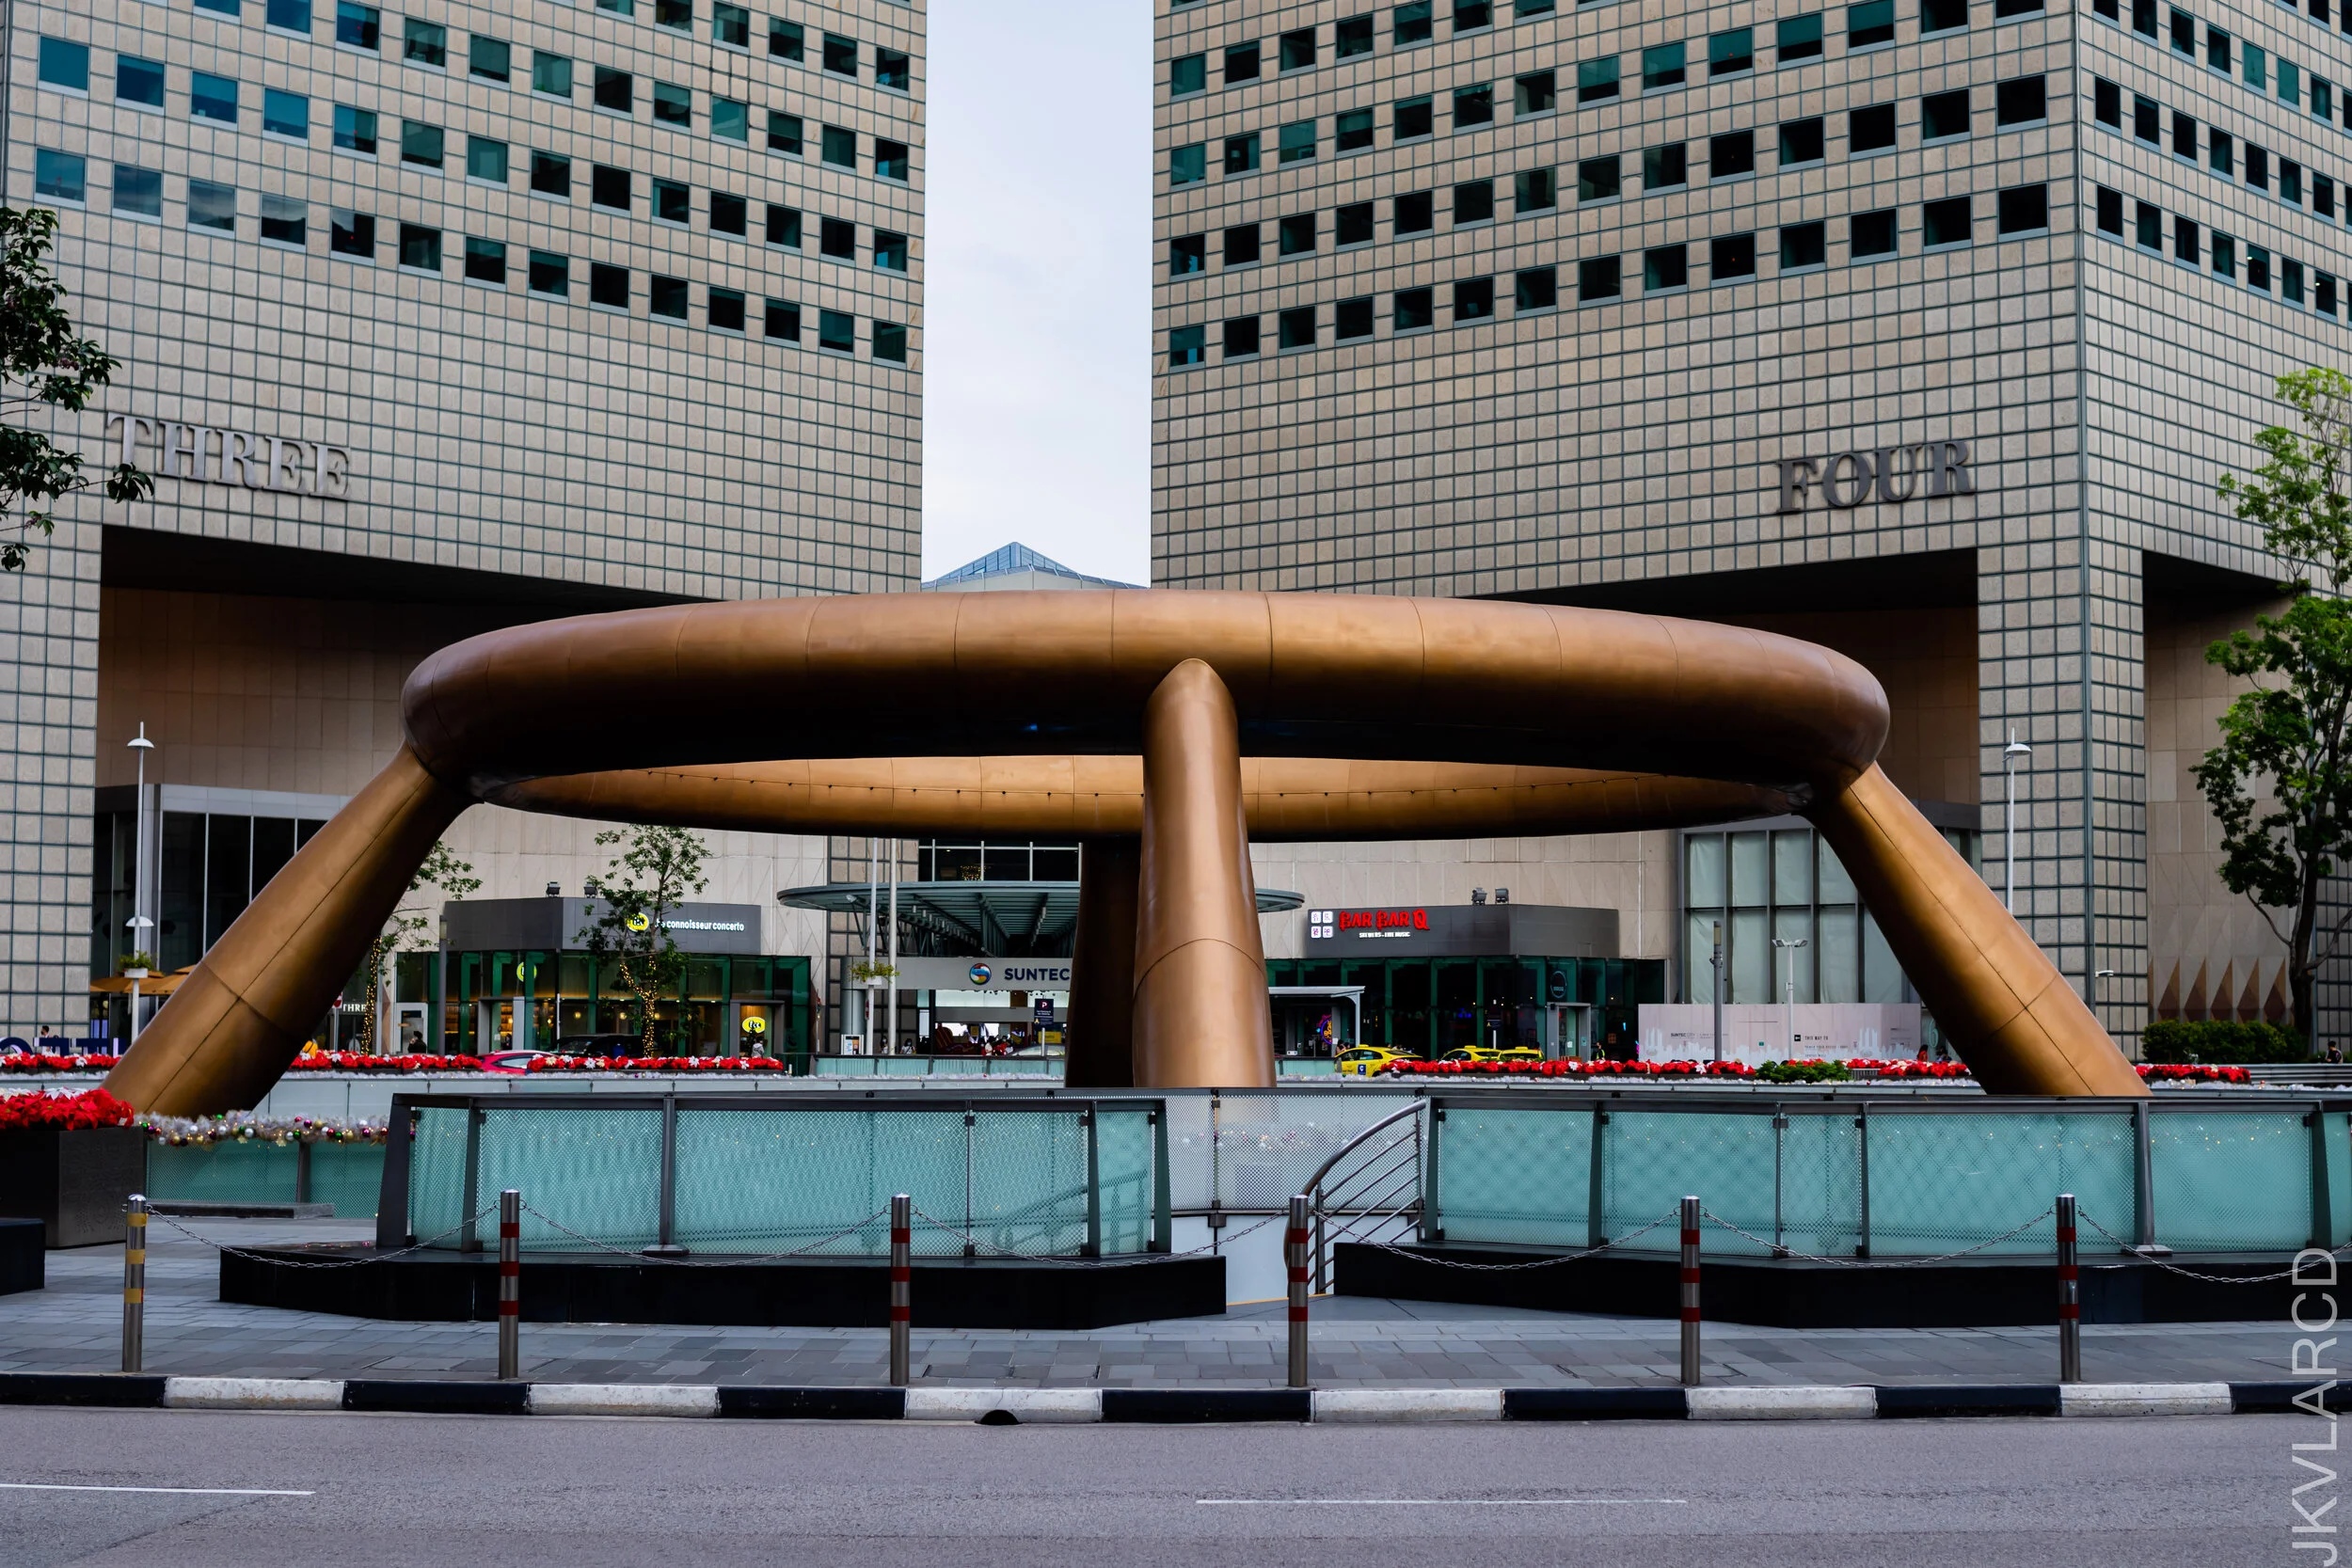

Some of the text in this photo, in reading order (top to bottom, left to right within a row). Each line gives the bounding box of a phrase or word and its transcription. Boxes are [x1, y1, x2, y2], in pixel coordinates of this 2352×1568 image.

[106, 412, 351, 501] THREE
[1776, 441, 1977, 515] FOUR
[667, 920, 711, 929] connoisseur
[712, 922, 744, 931] concerto
[1339, 909, 1430, 931] BAR BAR Q
[1004, 968, 1071, 981] SUNTEC
[342, 1004, 366, 1012] THRE
